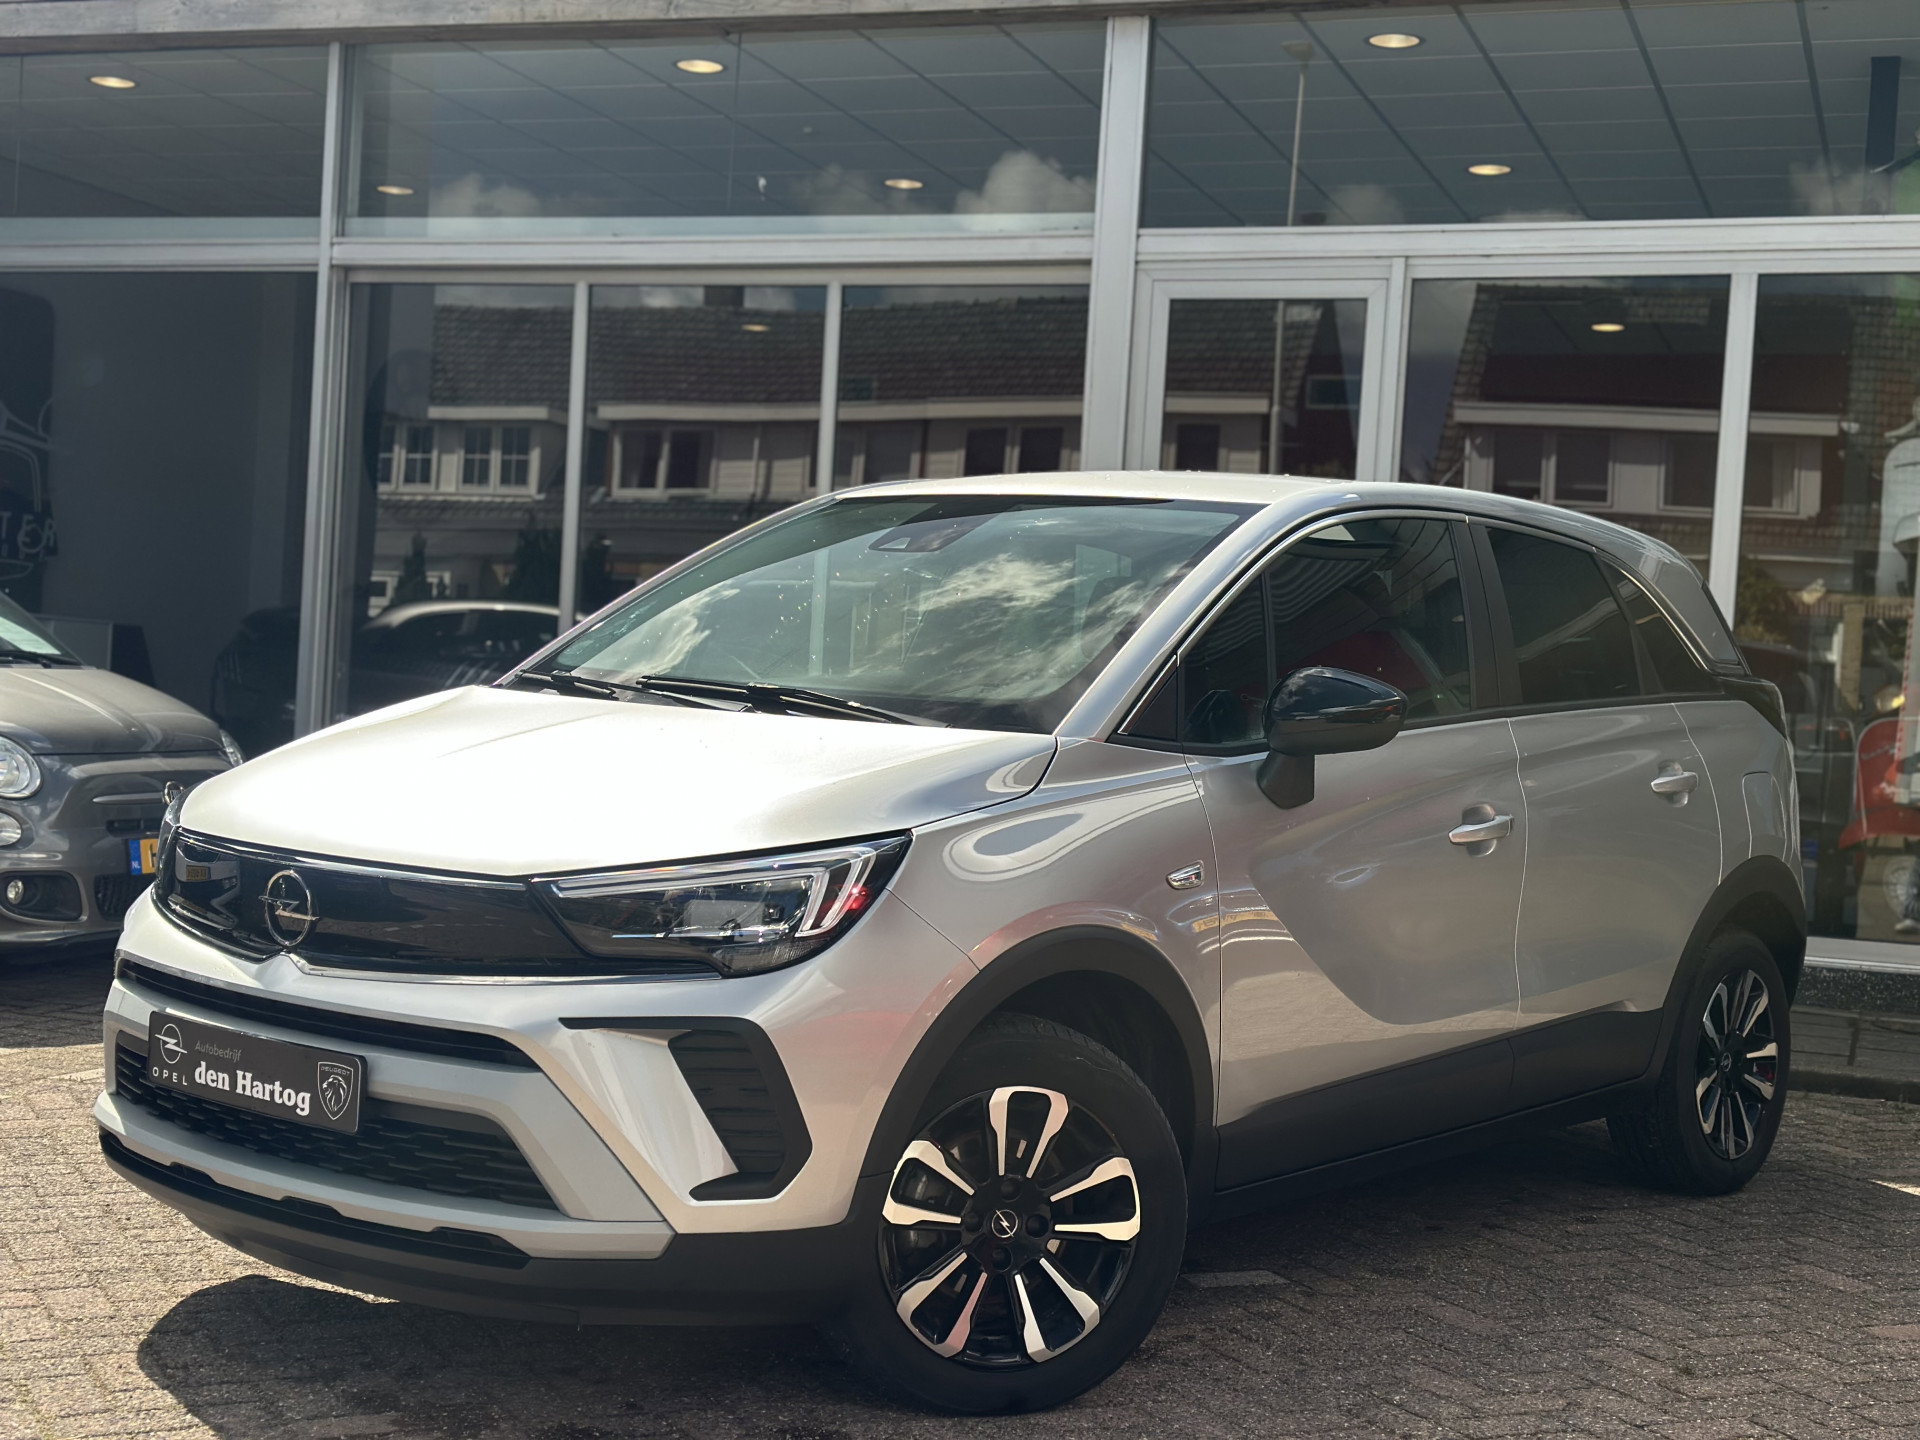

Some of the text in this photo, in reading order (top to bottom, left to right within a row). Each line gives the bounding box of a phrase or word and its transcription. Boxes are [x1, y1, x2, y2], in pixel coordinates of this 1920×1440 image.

[194, 1039, 242, 1062] Autobedrijf
[152, 1066, 188, 1086] OPEL
[320, 1066, 350, 1076] PEUGEOT
[194, 1060, 311, 1116] den Hartog
